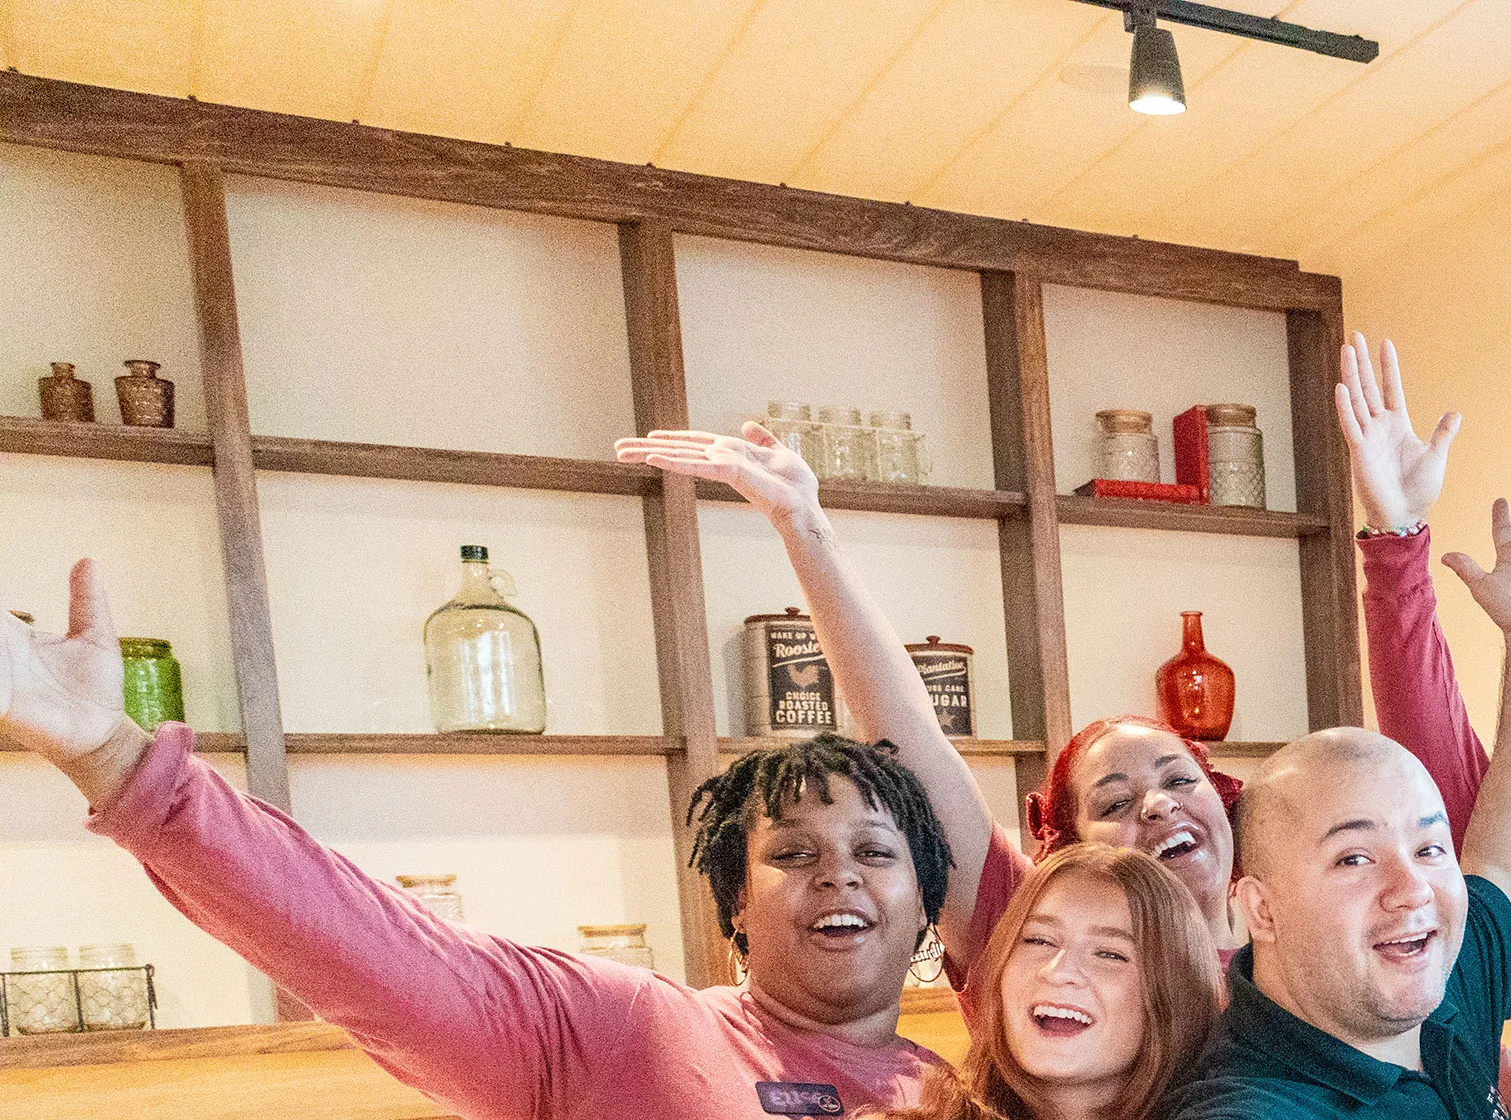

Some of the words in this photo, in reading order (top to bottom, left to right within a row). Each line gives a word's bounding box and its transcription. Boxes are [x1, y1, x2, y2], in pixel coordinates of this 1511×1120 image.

[779, 700, 829, 711] ROASTED
[932, 694, 968, 707] UGAR
[776, 711, 832, 724] COFFEE
